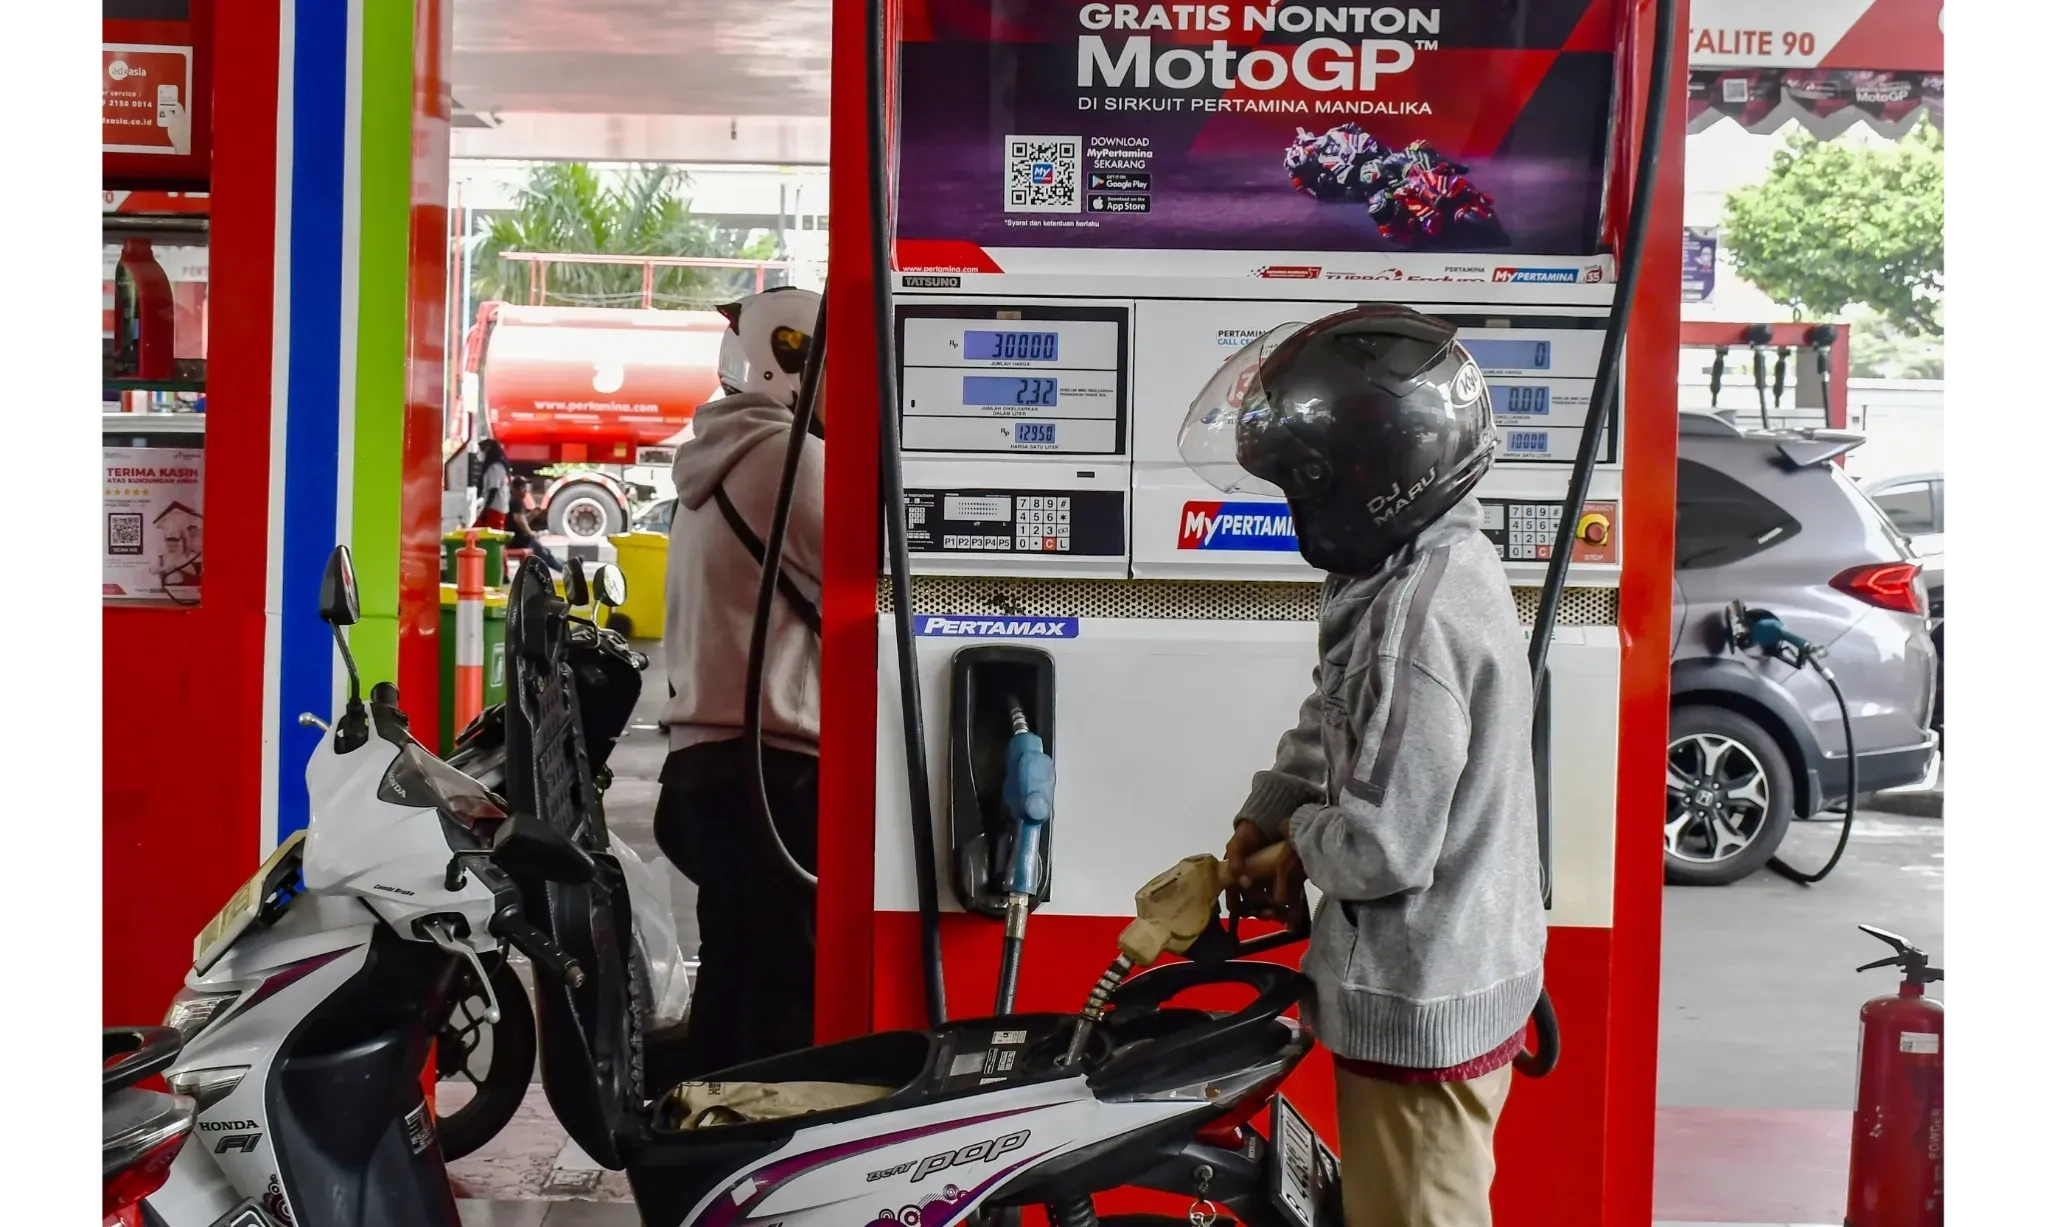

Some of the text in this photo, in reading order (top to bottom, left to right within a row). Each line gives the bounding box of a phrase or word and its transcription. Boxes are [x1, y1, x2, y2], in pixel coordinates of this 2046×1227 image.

[1079, 3, 1231, 31] GRATIS
[1689, 29, 1816, 56] ALITE 90
[1078, 96, 1433, 115] DI SIRKUIT PERTAMINA MANDALIKA
[1091, 136, 1150, 146] DOWNLOAD
[1087, 148, 1153, 158] MyPertamina
[1094, 159, 1146, 169] SEKARANG
[1106, 179, 1148, 190] Google Play
[1107, 202, 1146, 211] App Store
[903, 265, 978, 273] www.pertamina.com
[904, 276, 959, 287] TATSUNO
[1218, 329, 1268, 338] PERTAMIN
[992, 333, 1055, 359] 30000
[1217, 338, 1238, 346] CALL
[1534, 342, 1546, 367] 0
[534, 400, 659, 414] www.pertamina.com
[1511, 432, 1545, 449] 10000
[107, 468, 199, 477] TERIMA KASIH
[1020, 499, 1026, 507] 7
[1033, 499, 1040, 508] 8
[1047, 500, 1053, 508] 9
[1512, 508, 1519, 516] 7
[1526, 508, 1533, 516] 8
[1540, 508, 1546, 516] 9
[1020, 513, 1053, 522] 4 5 6
[1033, 526, 1040, 535] 2
[1047, 526, 1053, 535] 3
[1184, 511, 1297, 547] MyPERTAMI
[1512, 521, 1546, 530] 4 5 6
[945, 538, 955, 546] P1
[958, 538, 969, 546] P2
[985, 539, 996, 547] P4
[999, 539, 1010, 547] P5
[1020, 539, 1026, 548] 0
[1045, 539, 1054, 548] C
[1060, 540, 1066, 548] L
[1526, 535, 1533, 543] 2
[1540, 535, 1546, 543] 3
[1512, 548, 1519, 556] 0
[1538, 548, 1546, 556] C
[924, 617, 1066, 636] PERTAMAX
[373, 884, 394, 892] Combi
[198, 1120, 260, 1131] HONDA
[214, 1132, 263, 1153] FI
